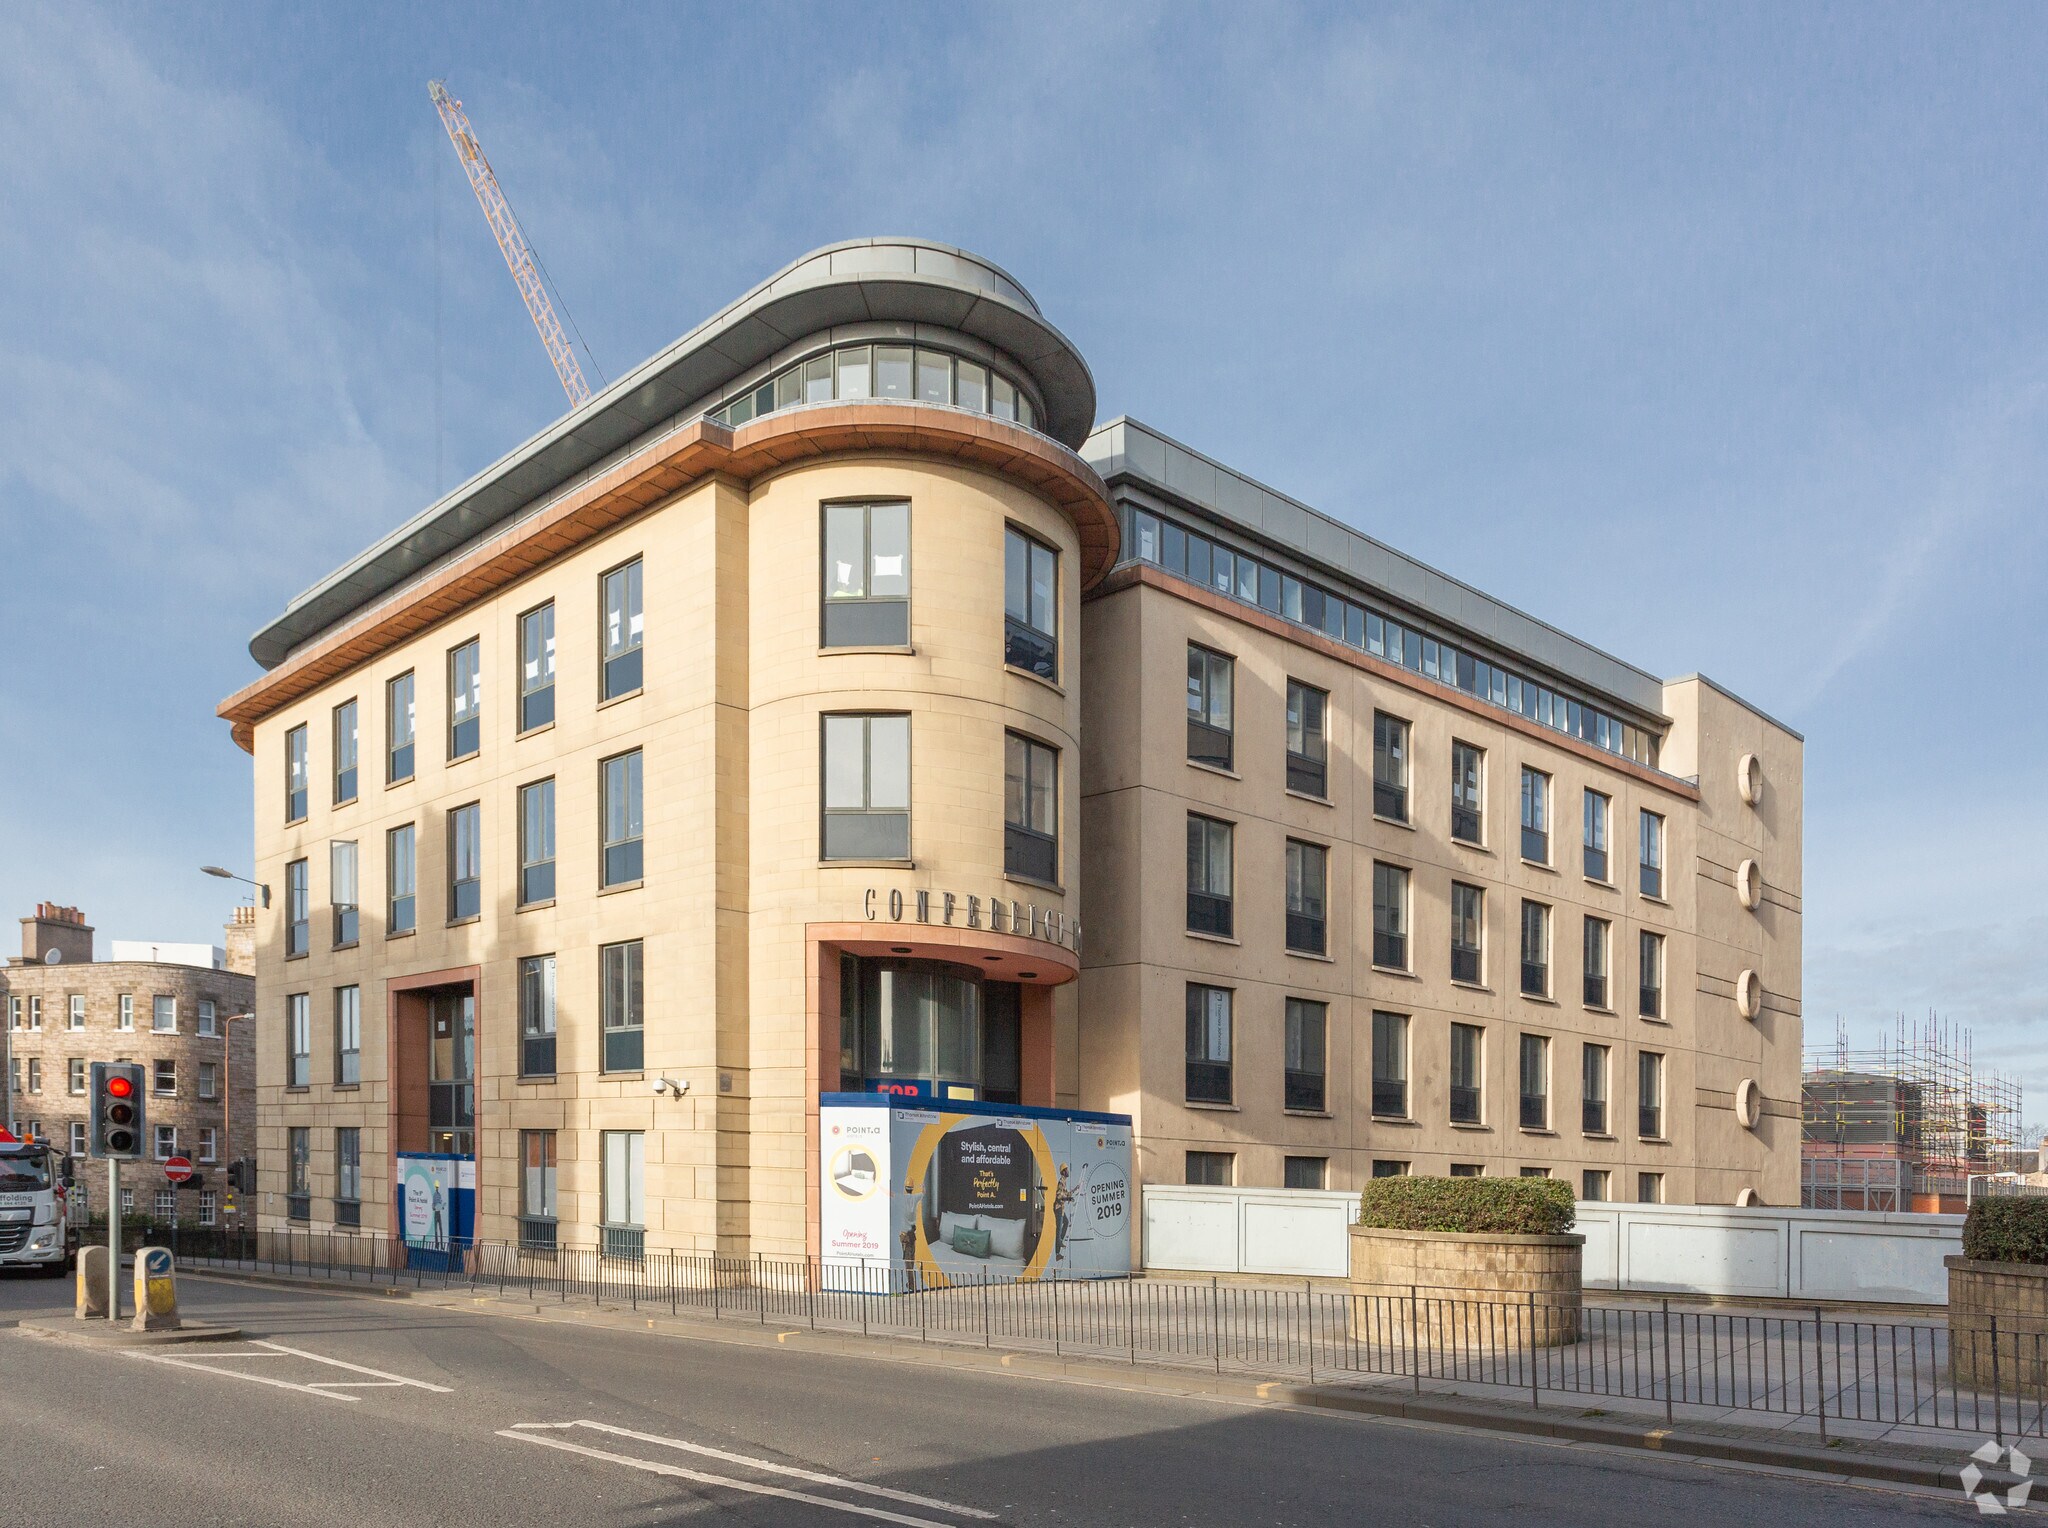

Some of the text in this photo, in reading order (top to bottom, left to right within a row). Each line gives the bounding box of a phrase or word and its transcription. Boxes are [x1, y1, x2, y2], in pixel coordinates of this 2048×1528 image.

[864, 888, 1065, 943] CONFERENCE
[960, 1141, 1011, 1153] Stylish, central
[961, 1154, 1011, 1165] and affordable
[973, 1177, 1000, 1191] Perfectly
[1090, 1179, 1125, 1194] OPENING
[1091, 1190, 1126, 1205] SUMMER
[1096, 1202, 1122, 1220] 2019
[842, 1229, 868, 1242] Opening
[831, 1240, 861, 1248] Summer
